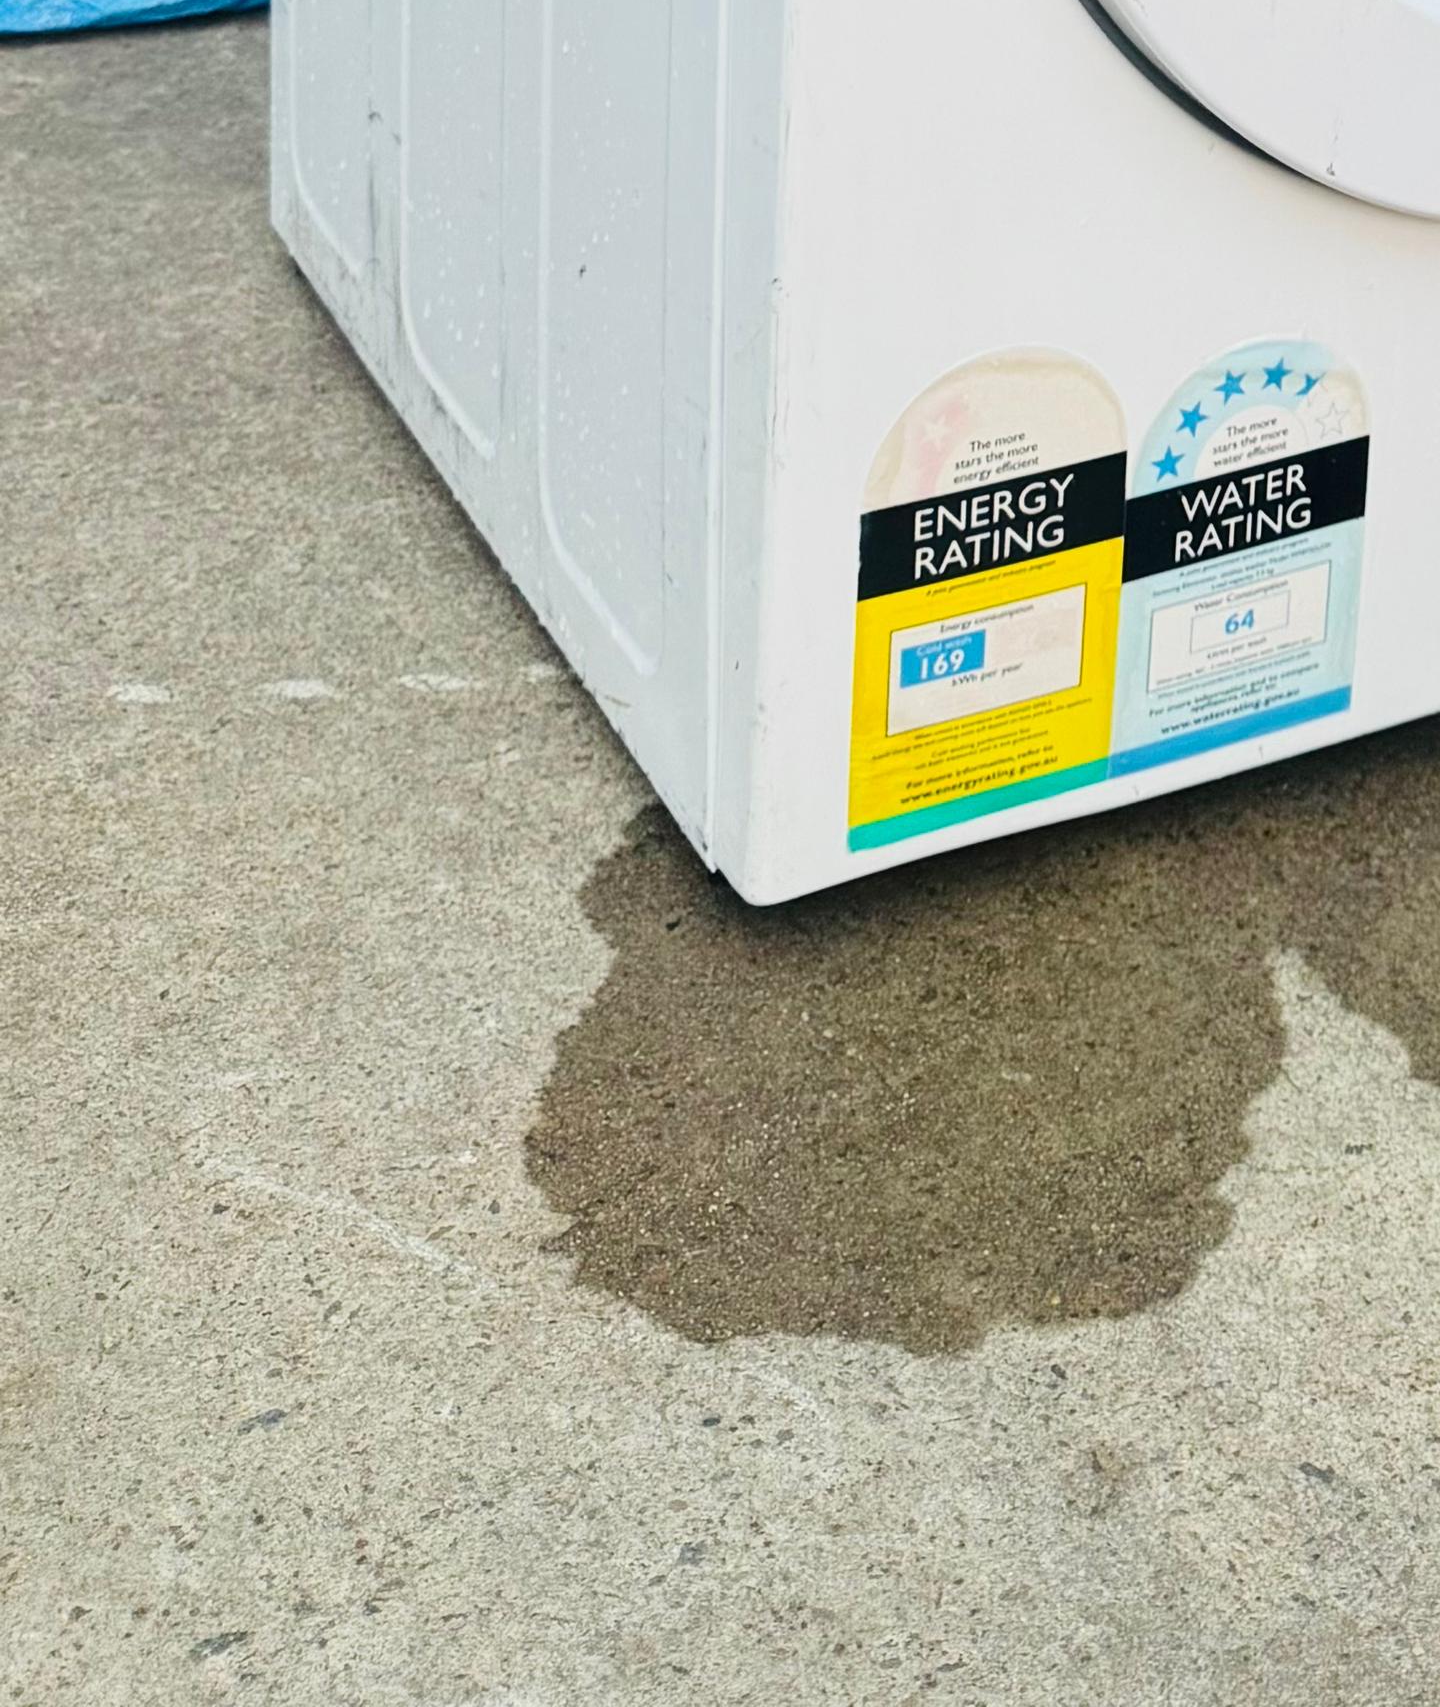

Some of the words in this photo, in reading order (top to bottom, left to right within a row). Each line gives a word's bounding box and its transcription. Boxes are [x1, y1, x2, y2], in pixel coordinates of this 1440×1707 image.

[1227, 425, 1247, 437] The
[1249, 418, 1277, 431] more
[1240, 436, 1258, 447] the
[1260, 428, 1288, 440] more
[969, 440, 991, 452] The
[994, 432, 1026, 447] more
[1213, 453, 1244, 467] water
[1246, 441, 1287, 459] efficient
[953, 469, 992, 484] energy
[995, 456, 1039, 475] efficient
[955, 456, 982, 470] stars
[985, 451, 1005, 463] the
[1007, 443, 1038, 457] more
[1180, 464, 1307, 522] WATER
[913, 473, 1074, 543] ENERGY
[1174, 498, 1312, 563] RATING
[913, 514, 1065, 580] RATING
[1224, 608, 1255, 635] 64
[919, 648, 965, 681] 169
